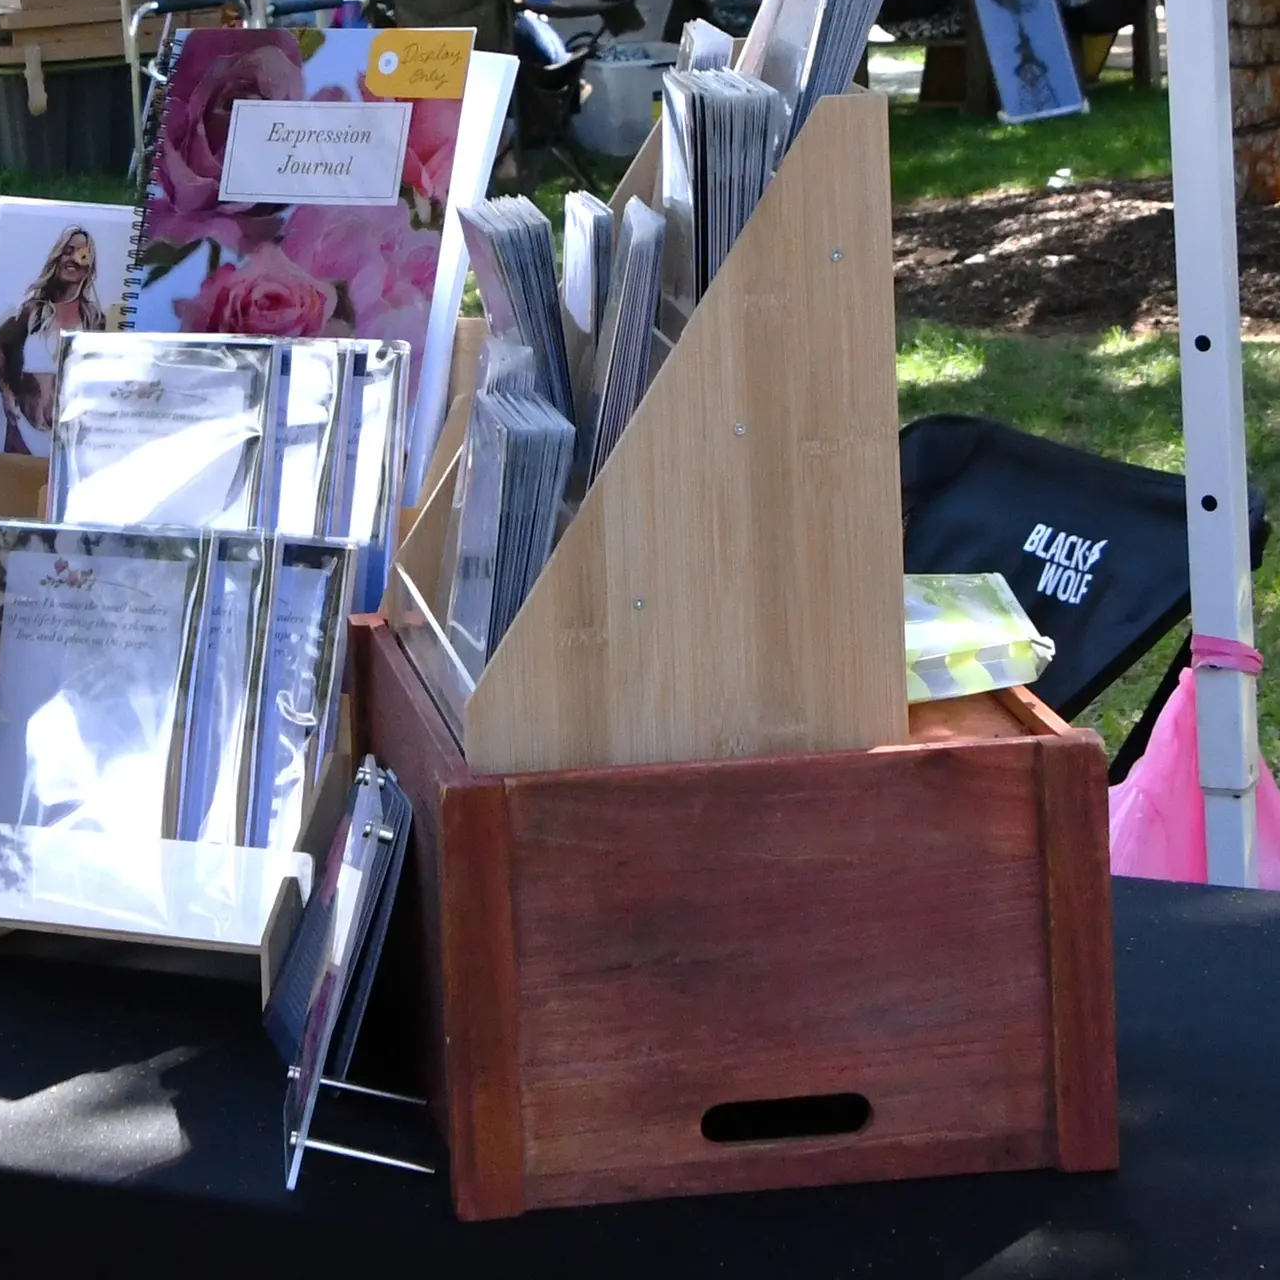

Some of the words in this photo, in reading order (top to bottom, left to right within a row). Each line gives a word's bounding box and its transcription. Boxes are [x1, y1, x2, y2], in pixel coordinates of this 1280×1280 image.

[401, 41, 464, 66] Display
[408, 68, 449, 90] Only
[266, 121, 373, 149] Expression
[277, 153, 354, 177] Journal
[1023, 523, 1100, 572] BLACK
[1036, 561, 1093, 604] WOLF
